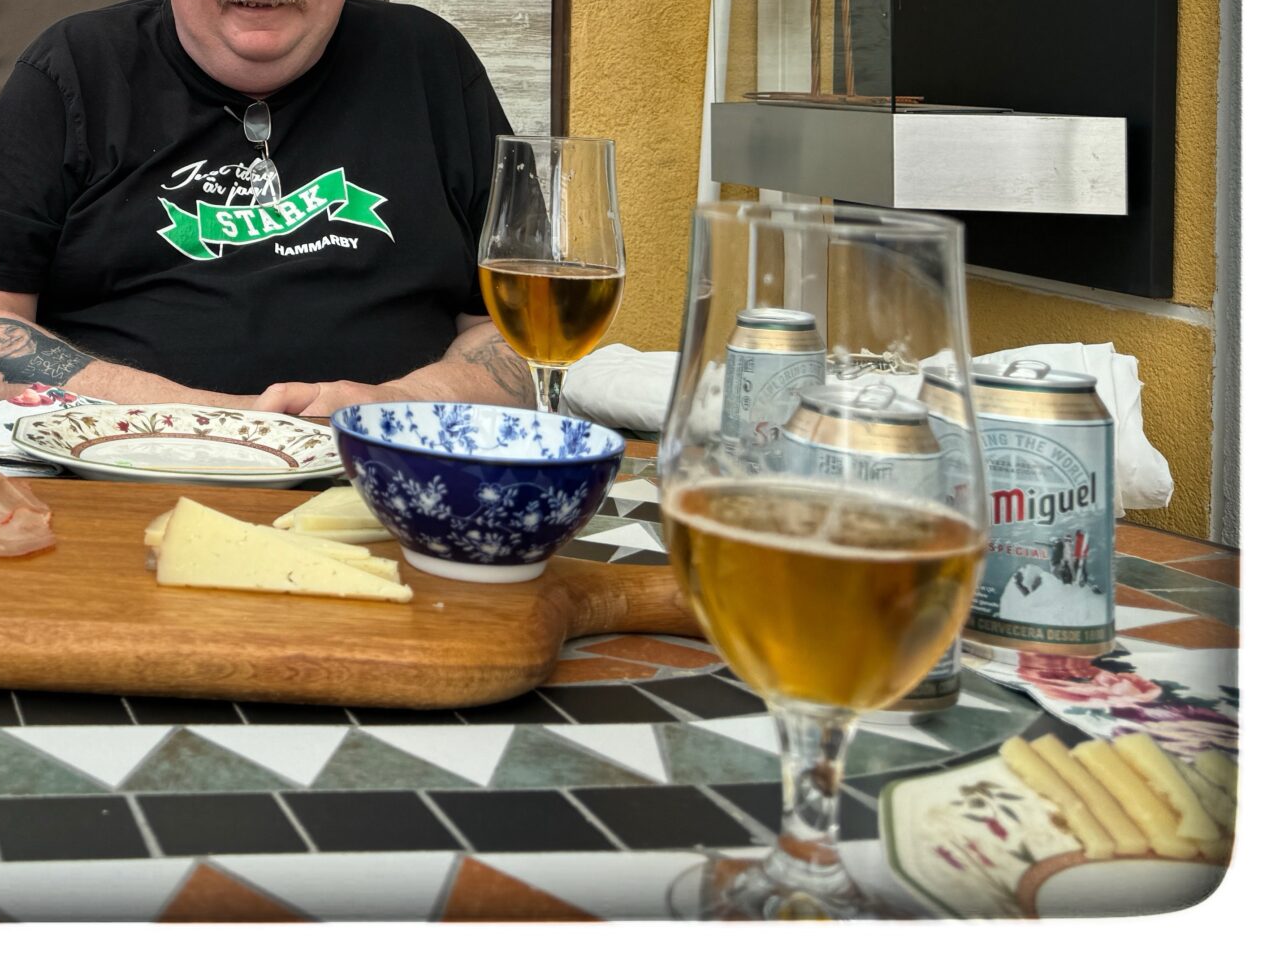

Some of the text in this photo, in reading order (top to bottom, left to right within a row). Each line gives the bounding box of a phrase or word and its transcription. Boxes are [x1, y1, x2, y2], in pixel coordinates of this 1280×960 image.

[202, 176, 226, 195] är
[216, 184, 328, 238] STARK
[274, 234, 359, 256] HAMMARBY
[1015, 434, 1047, 453] THE
[992, 471, 1097, 526] Miguel
[987, 542, 1049, 560] SPECIAL
